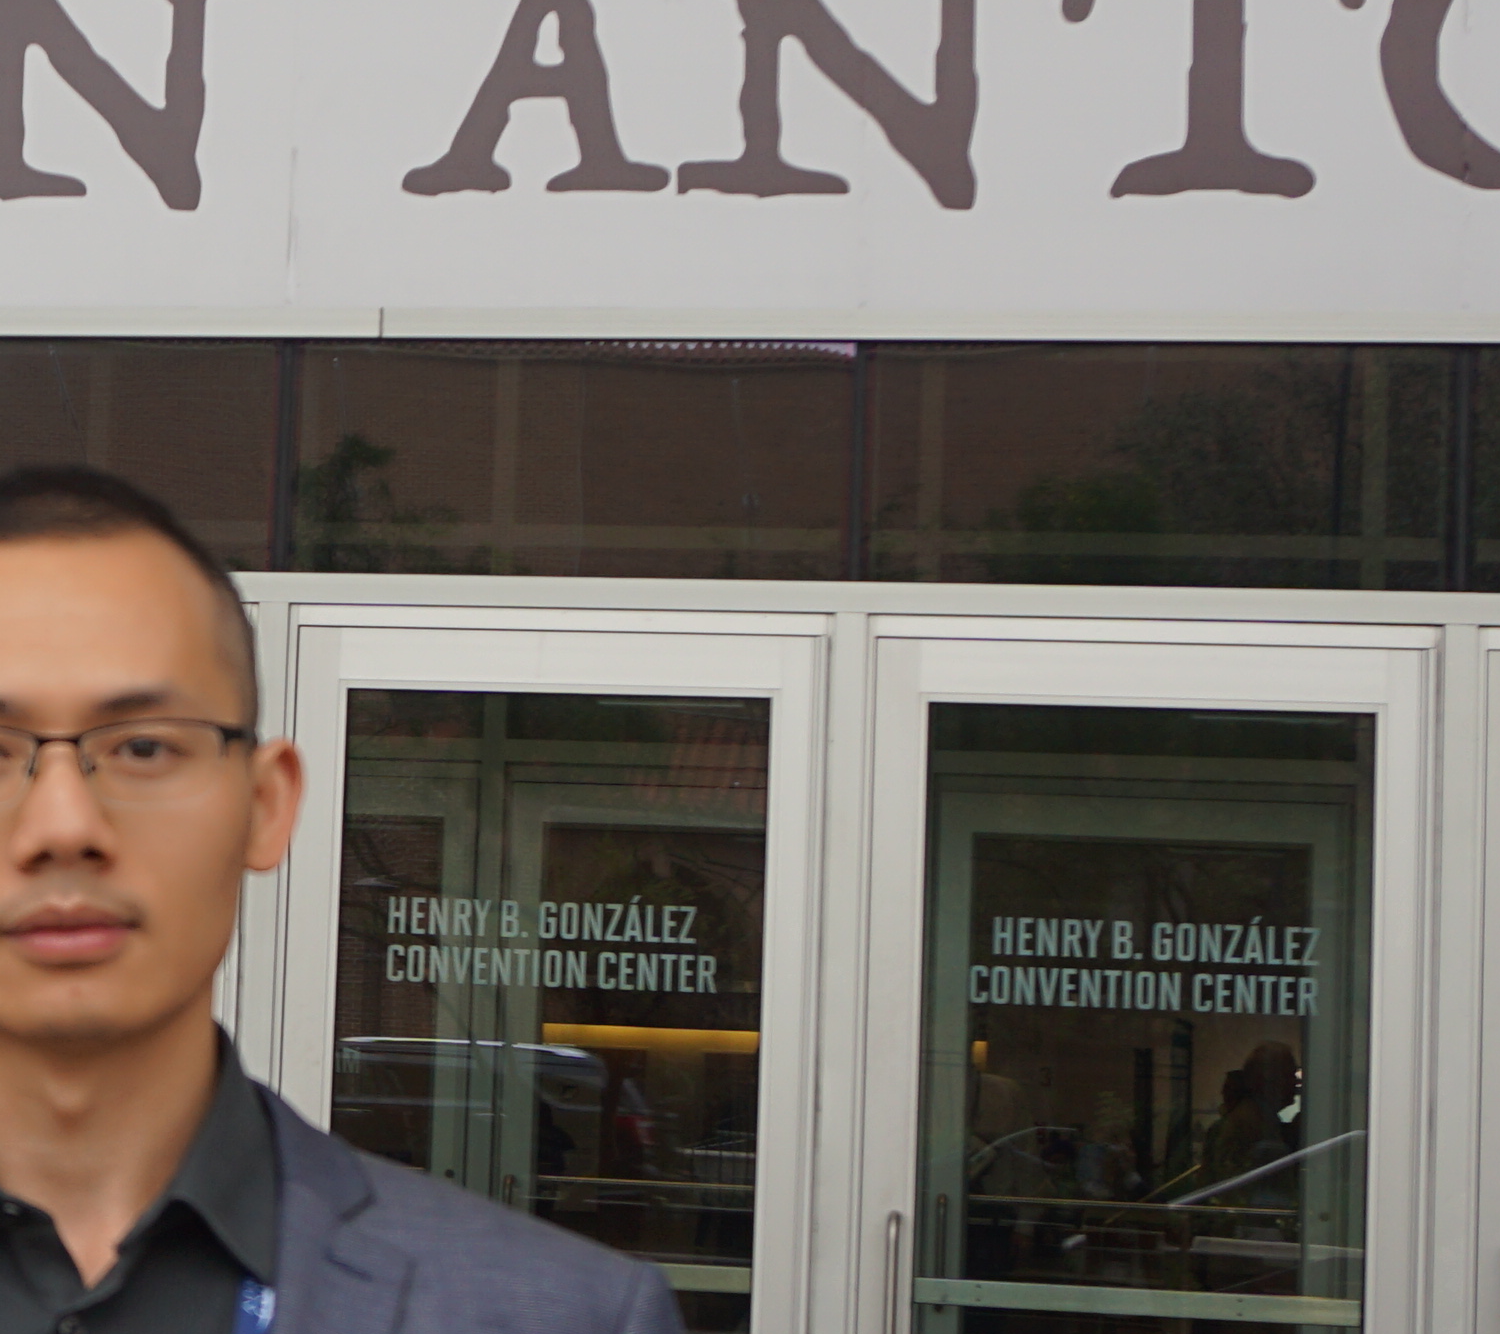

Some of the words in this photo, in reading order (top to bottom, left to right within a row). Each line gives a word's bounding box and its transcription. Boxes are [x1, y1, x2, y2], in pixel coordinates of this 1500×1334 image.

[387, 896, 492, 938] HENRY
[500, 899, 528, 939] B.
[538, 895, 697, 944] GONZÁLEZ
[992, 916, 1103, 959] HENRY
[1111, 920, 1143, 960] B.
[1151, 915, 1321, 966] GONZÁLEZ
[386, 944, 587, 989] CONVENTION
[596, 951, 717, 994] CENTER
[968, 965, 1181, 1011] CONVENTION
[1192, 973, 1319, 1016] CENTER
